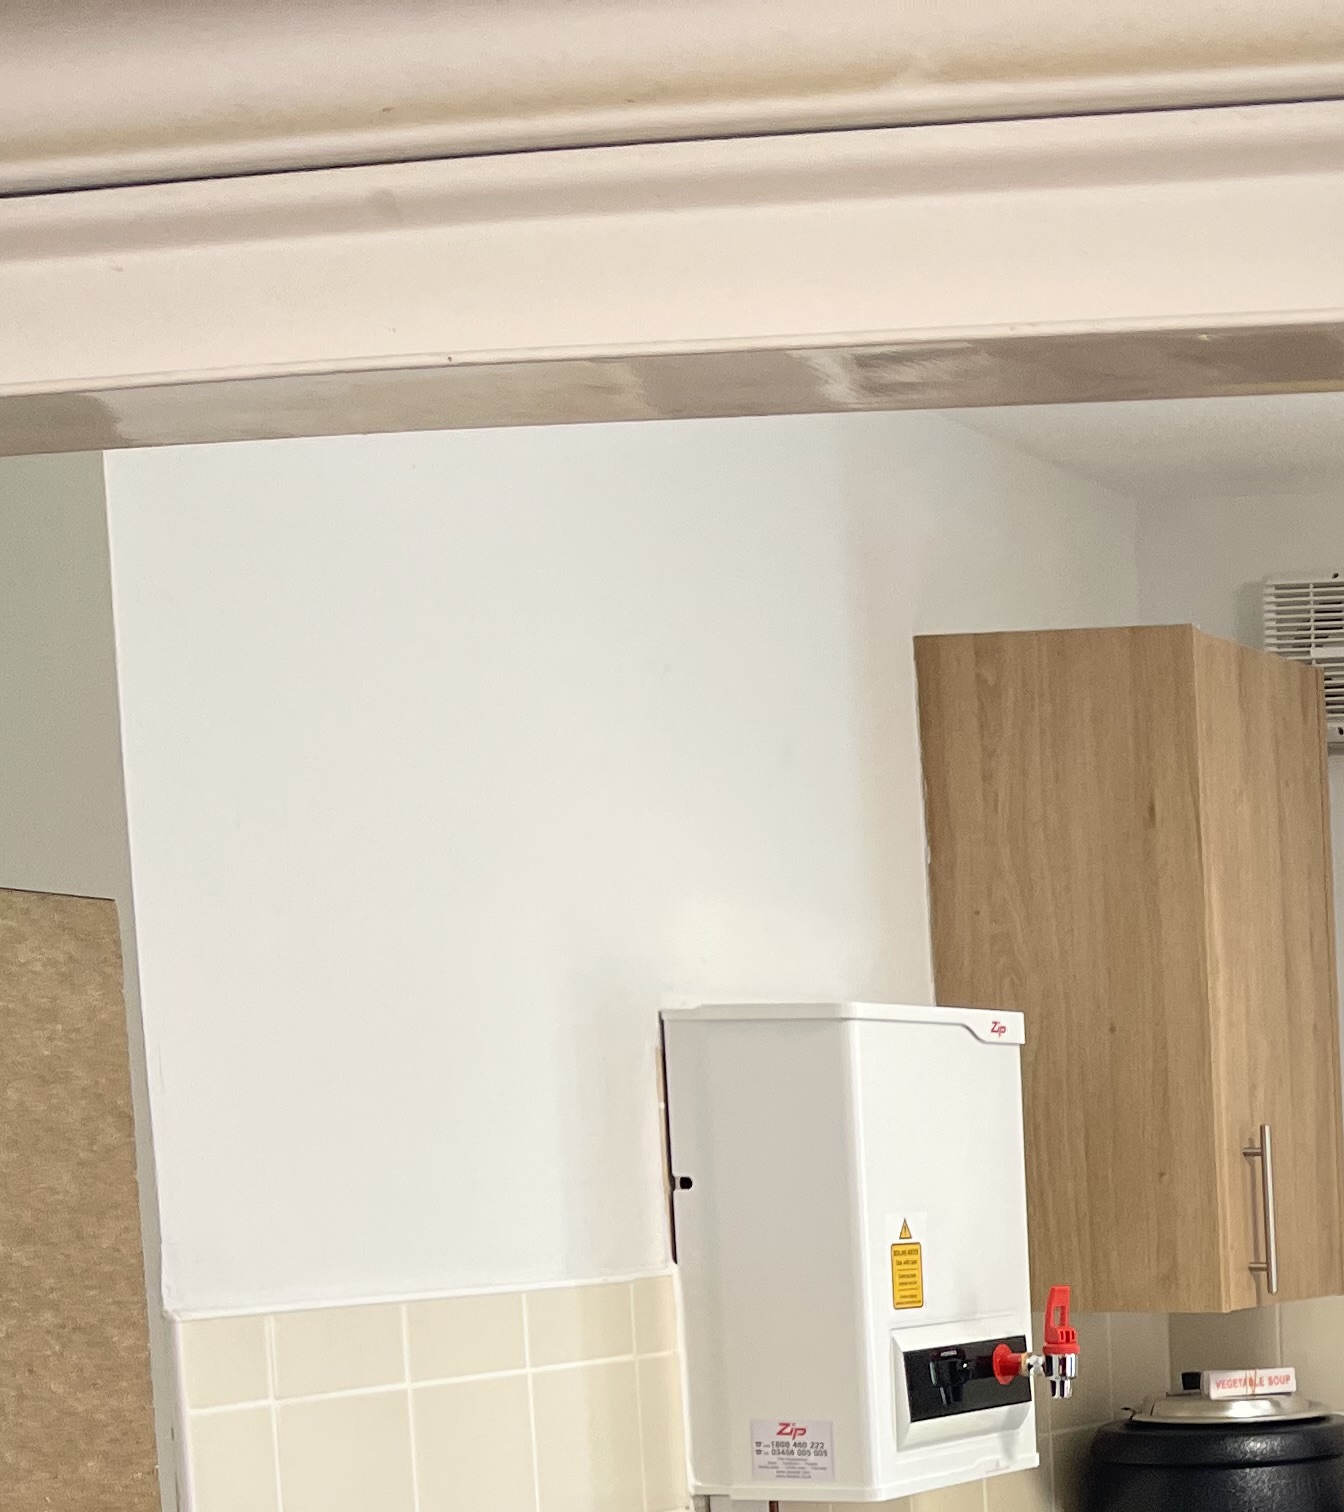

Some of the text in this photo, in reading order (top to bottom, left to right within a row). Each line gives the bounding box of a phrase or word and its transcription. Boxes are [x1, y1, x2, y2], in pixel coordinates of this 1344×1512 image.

[990, 1021, 1006, 1037] Zip
[1215, 1374, 1291, 1389] VEGETABLE SOUP
[776, 1422, 806, 1440] Zip
